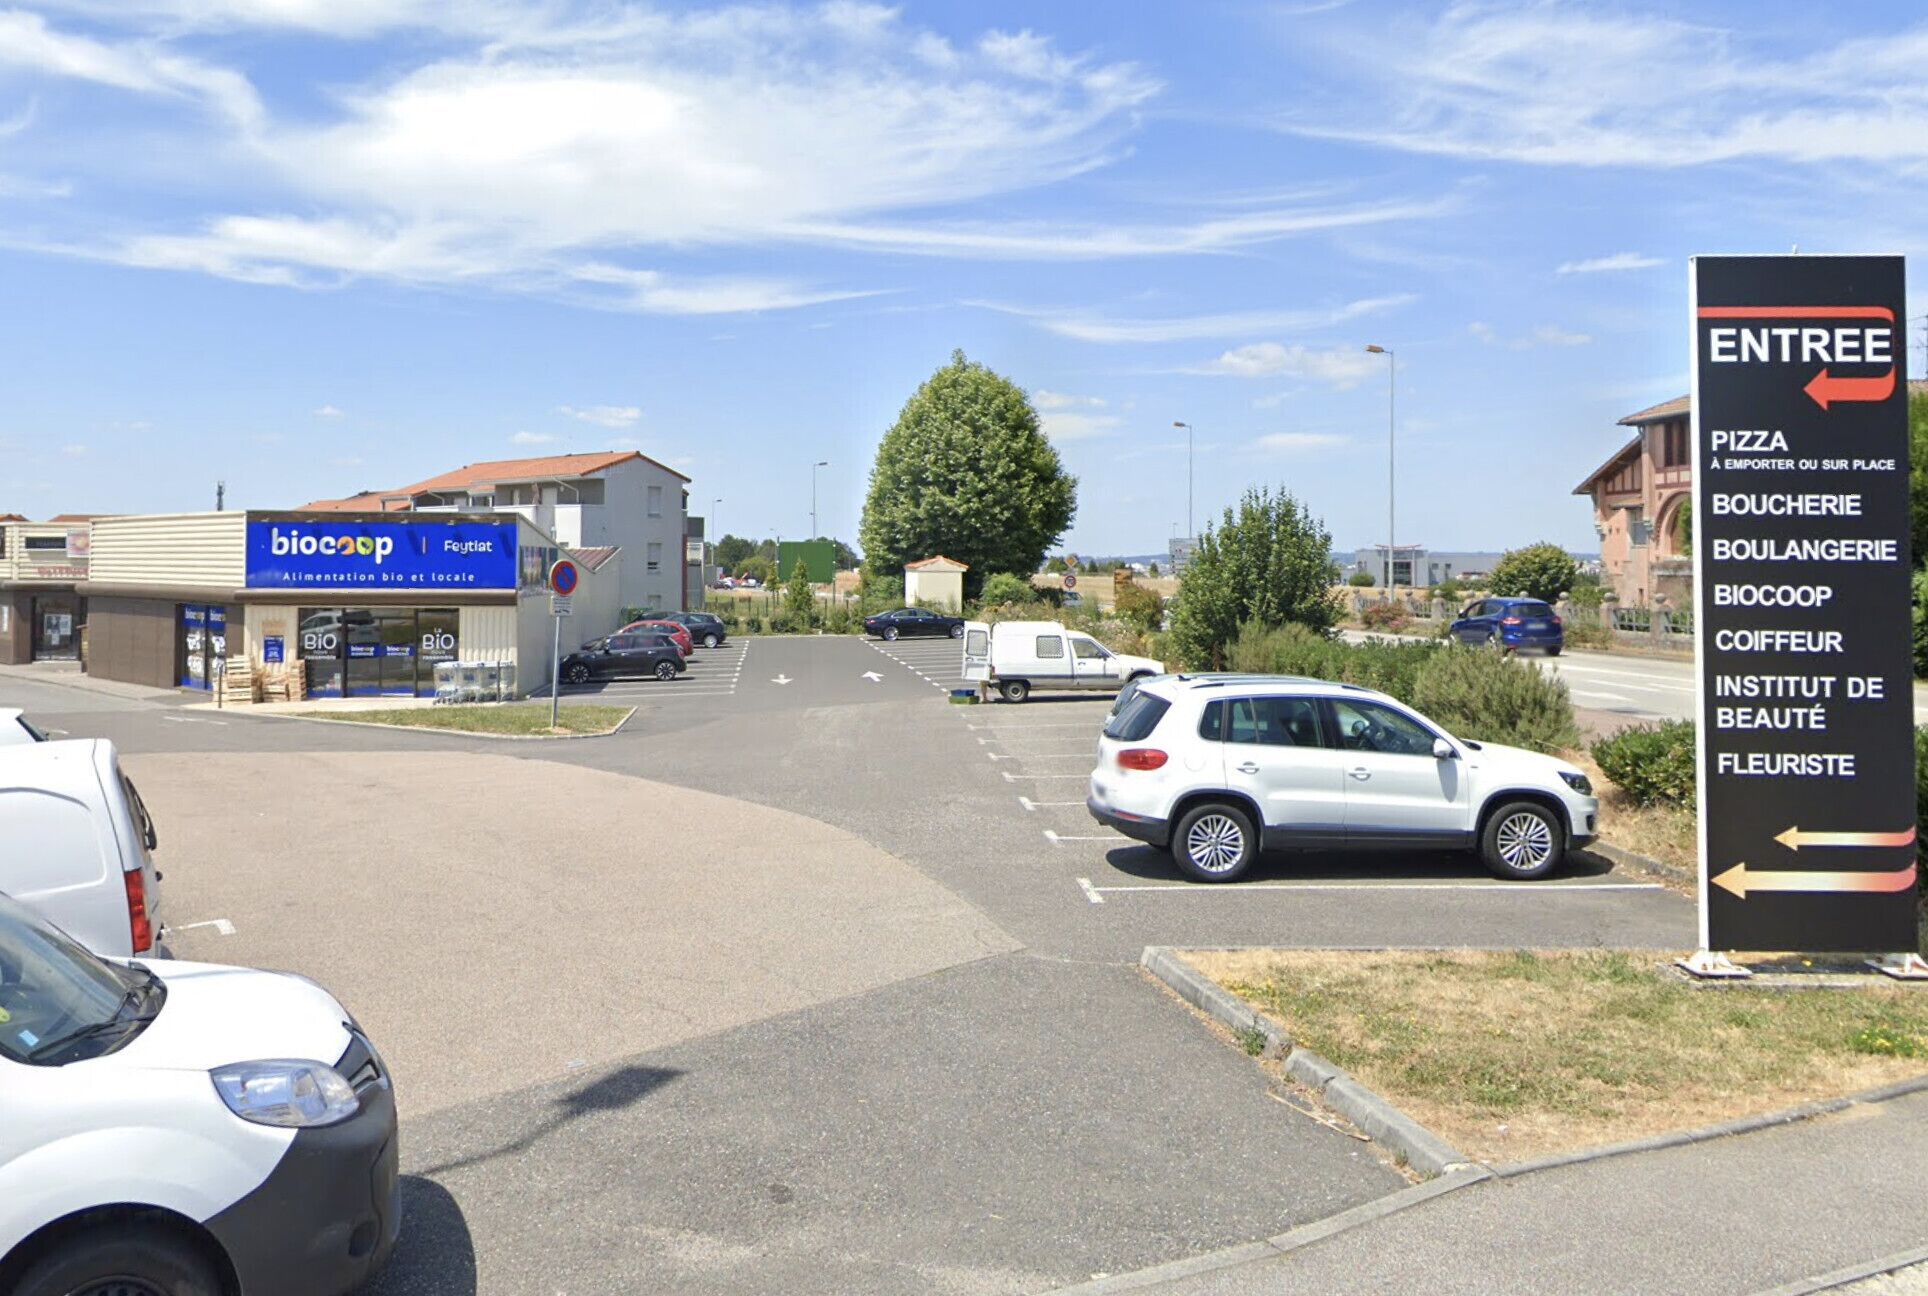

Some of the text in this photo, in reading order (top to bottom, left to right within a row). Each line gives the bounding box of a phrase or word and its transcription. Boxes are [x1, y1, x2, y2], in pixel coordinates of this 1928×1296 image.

[1710, 328, 1892, 363] ENTREE
[1711, 431, 1789, 451] PIZZA
[1711, 457, 1896, 470] À EMPORTER OU SUR PLACE
[1713, 494, 1862, 515] BOUCHERIE
[271, 527, 394, 565] biocoop
[1713, 538, 1897, 561] BOULANGERIE
[282, 572, 475, 582] Alimentation bio et locale
[1714, 584, 1833, 606] BIOCOOP
[1715, 629, 1844, 652] COIFFEUR
[1715, 675, 1884, 698] INSTITUT DE
[1716, 703, 1826, 729] BEAUTÉ
[1717, 752, 1856, 776] FLEURISTE
